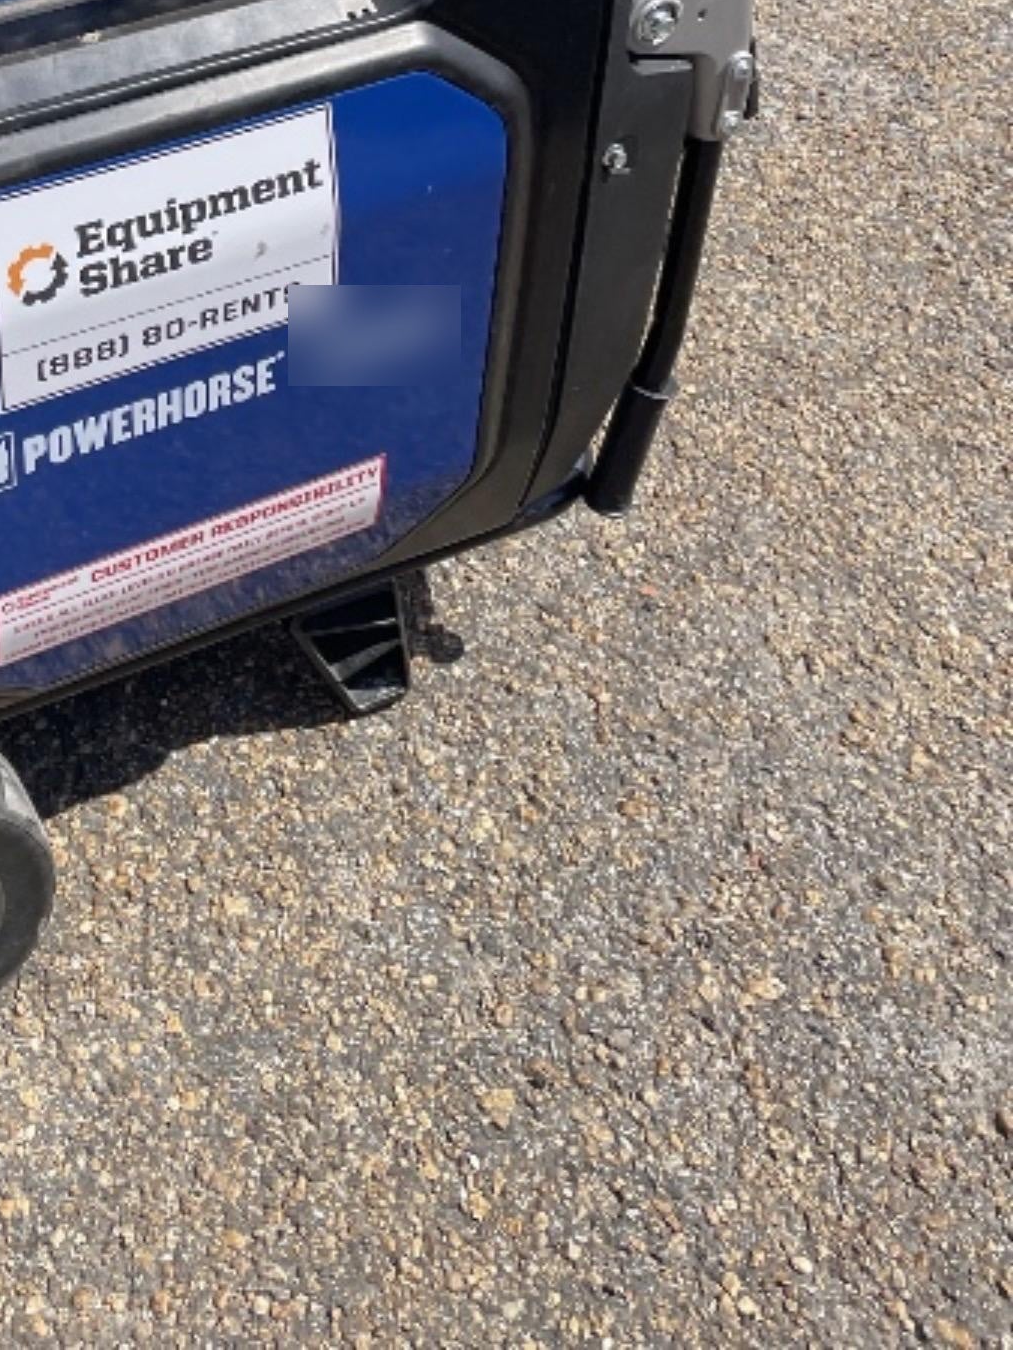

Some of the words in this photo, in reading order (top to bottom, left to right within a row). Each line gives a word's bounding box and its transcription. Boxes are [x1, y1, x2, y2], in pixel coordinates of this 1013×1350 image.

[74, 158, 324, 258] Equipment
[79, 236, 214, 297] Share
[37, 333, 130, 382] (888)
[142, 281, 300, 347] 80-RENT
[22, 358, 277, 475] POWERHORSE
[91, 530, 205, 582] CUSTOMER
